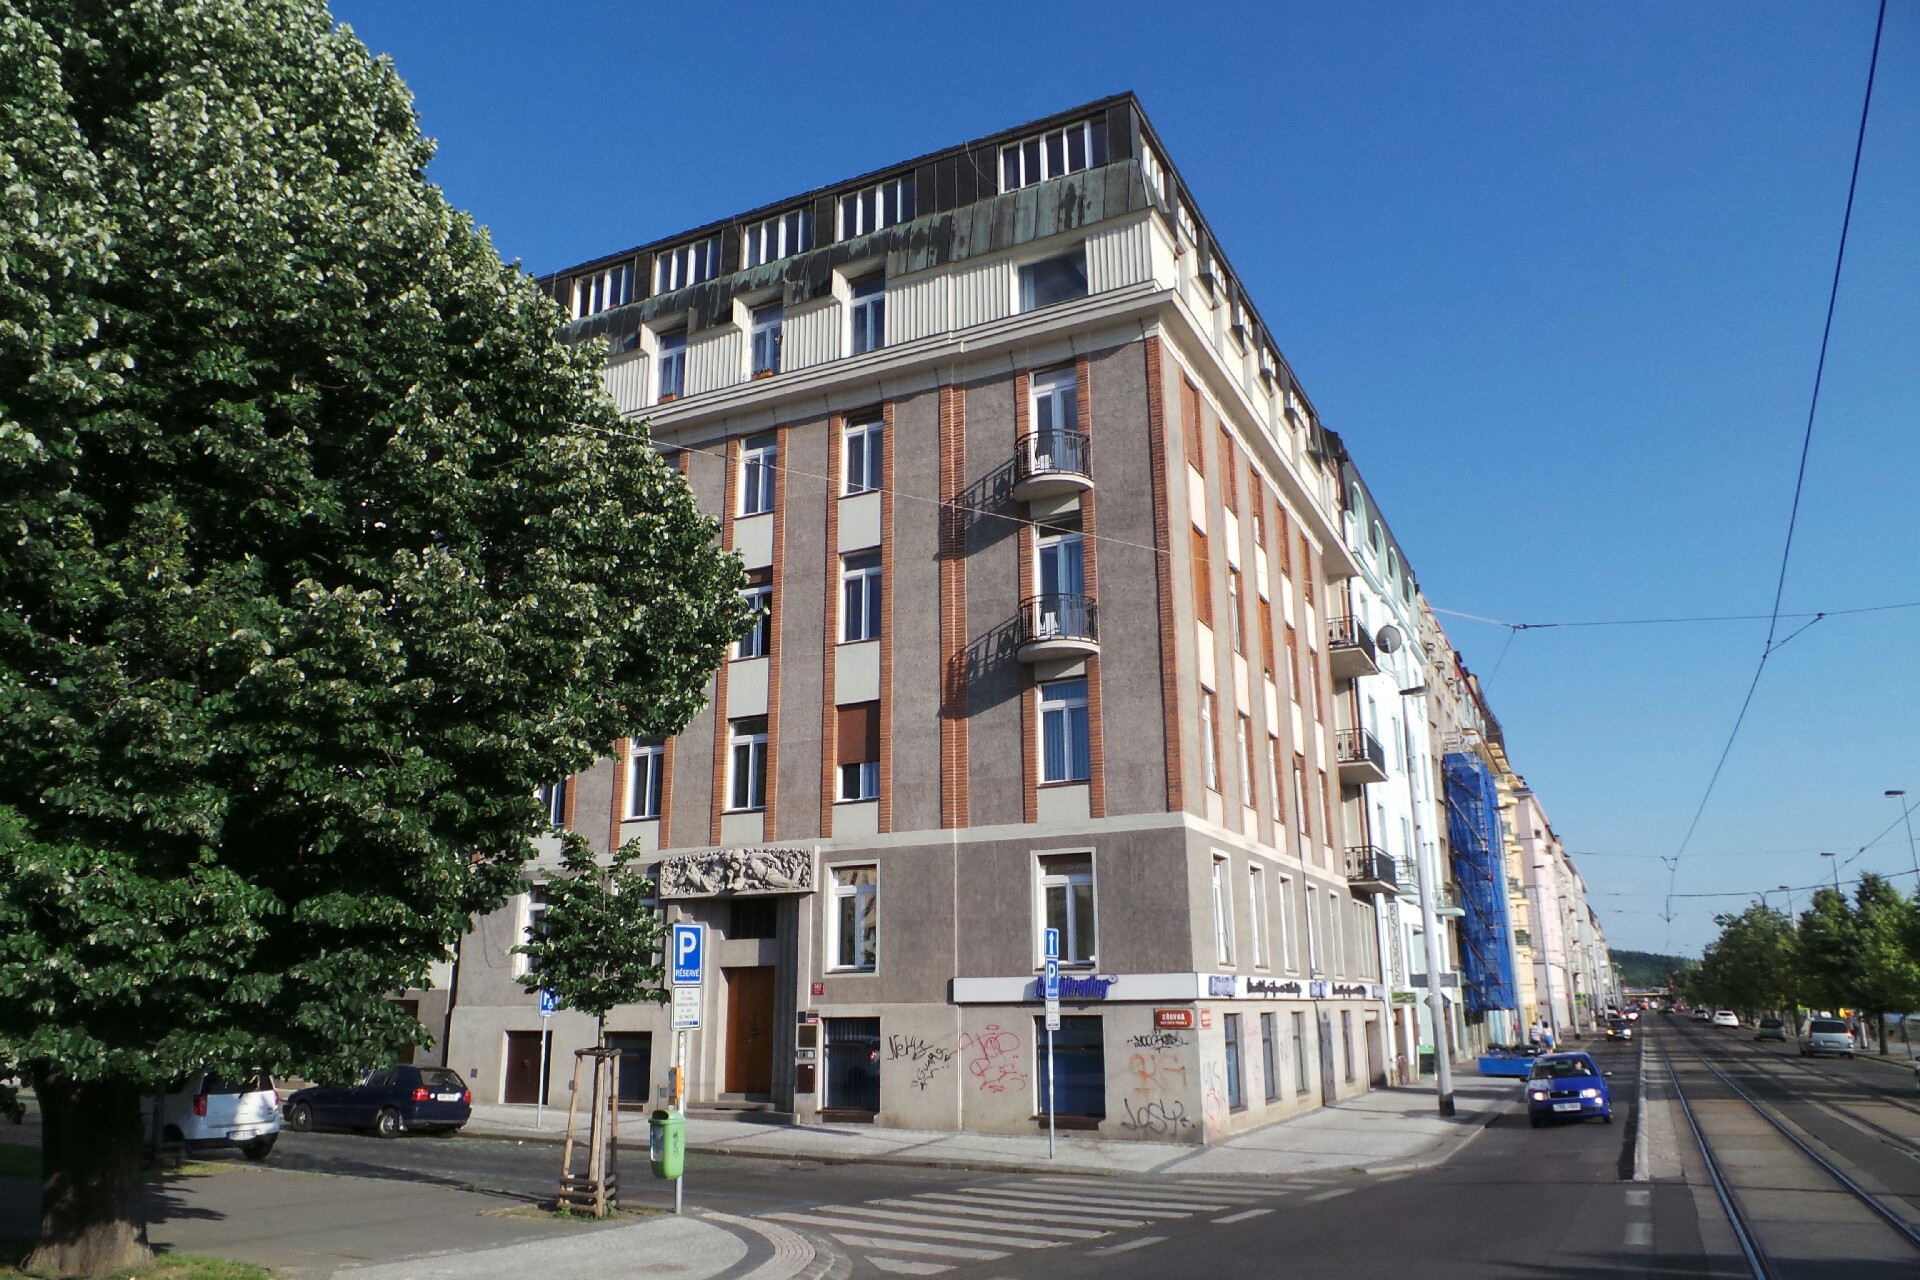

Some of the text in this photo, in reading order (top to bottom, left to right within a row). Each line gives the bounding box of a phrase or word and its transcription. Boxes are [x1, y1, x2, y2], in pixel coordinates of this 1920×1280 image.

[679, 931, 697, 966] P
[676, 968, 700, 977] RÉSERVÉ
[1048, 963, 1056, 986] P
